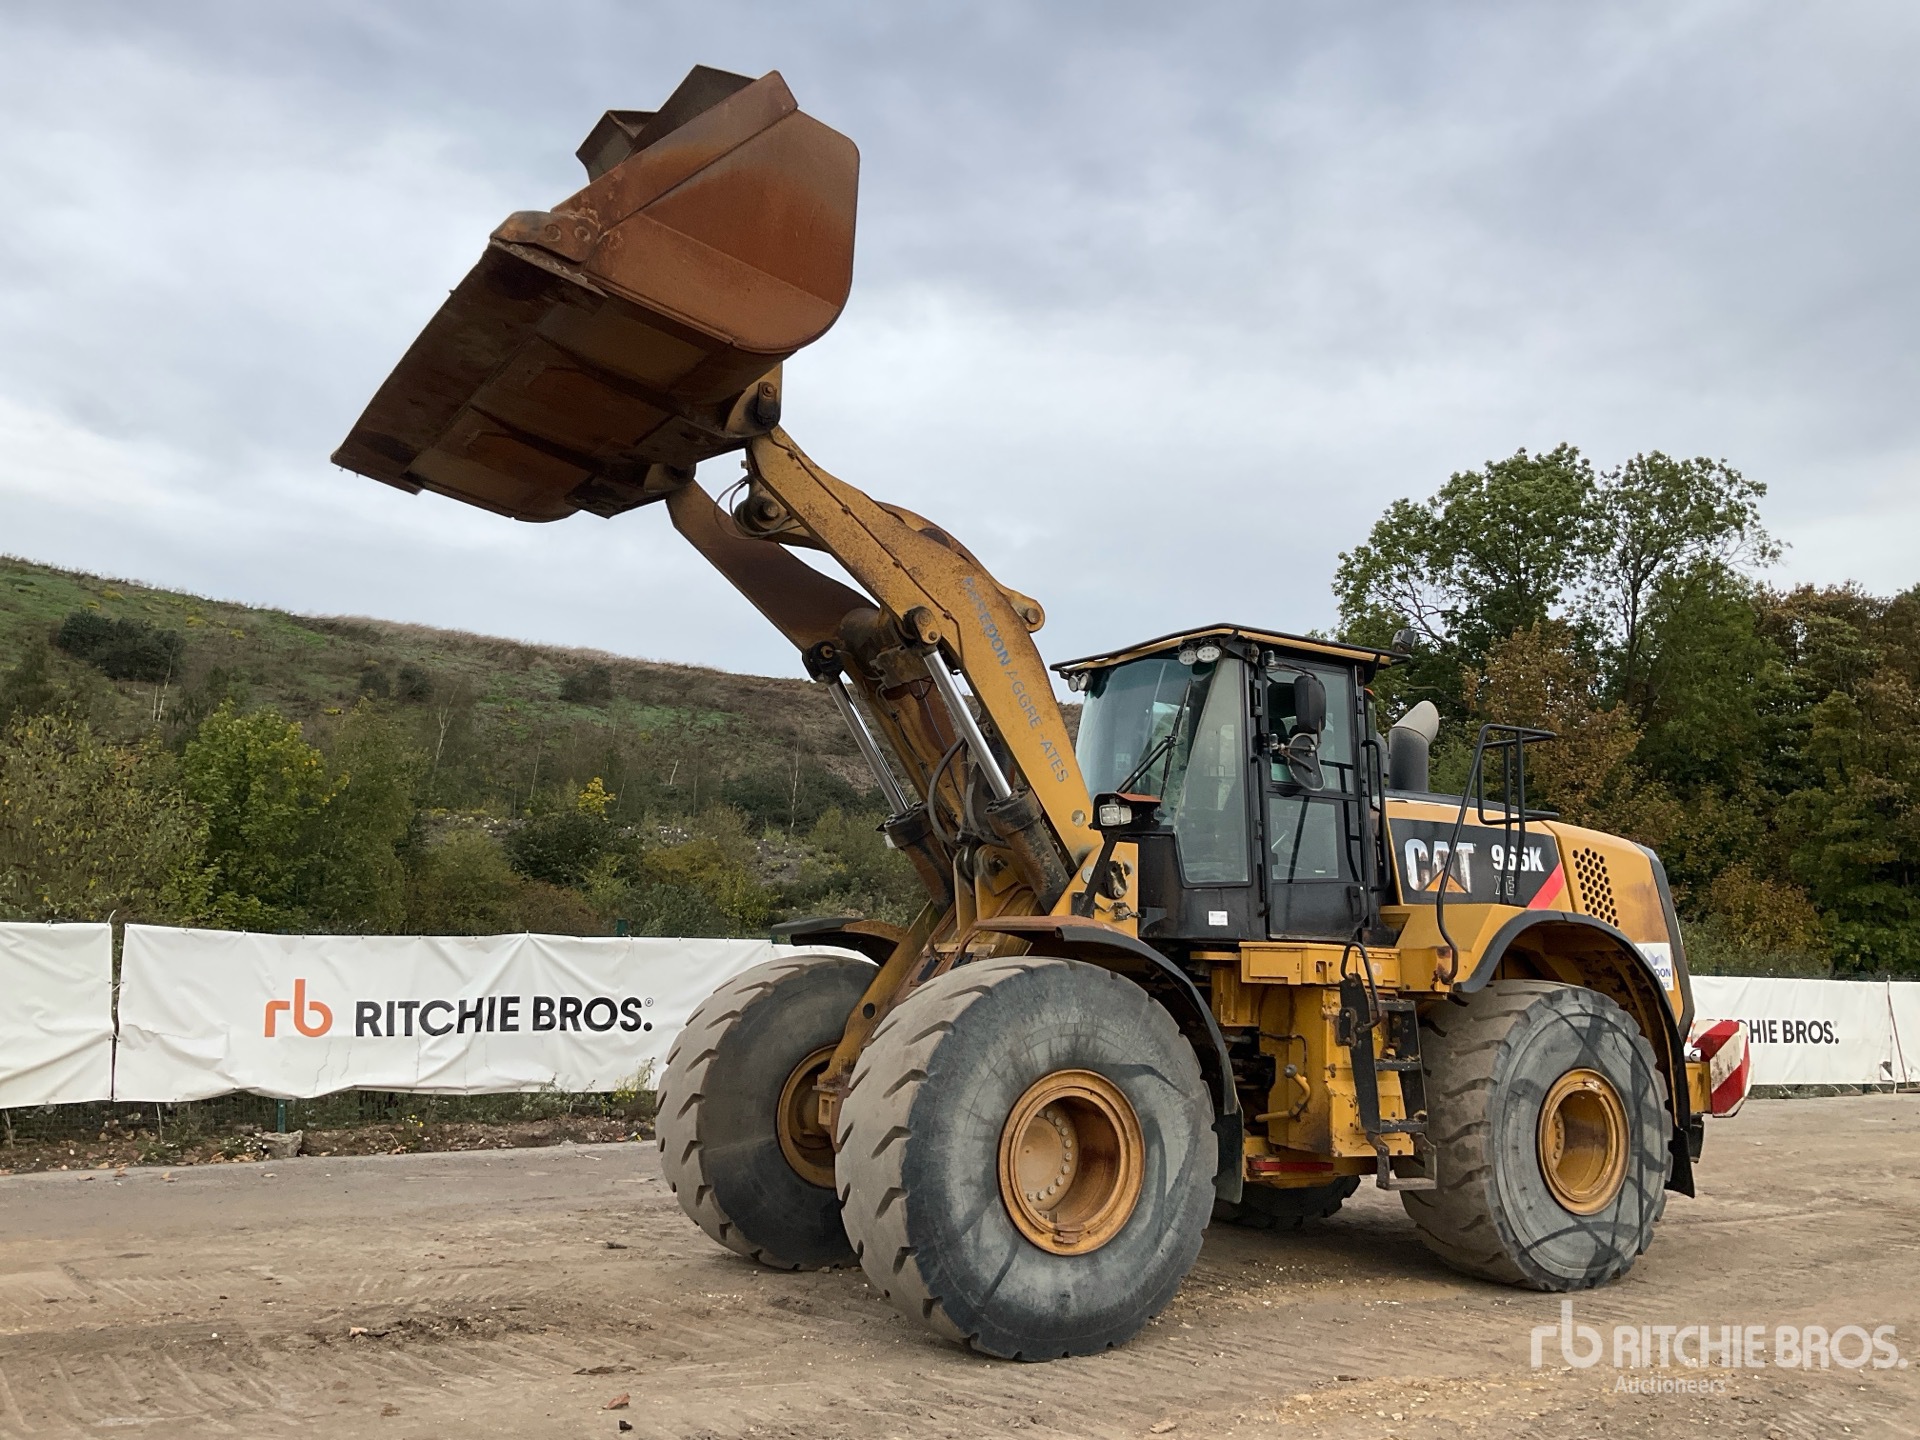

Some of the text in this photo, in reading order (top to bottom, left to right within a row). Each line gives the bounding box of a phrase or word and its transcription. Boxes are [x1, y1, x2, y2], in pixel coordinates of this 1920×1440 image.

[1004, 667, 1069, 782] AGGREATES
[1404, 838, 1545, 893] CAT 966K
[264, 978, 653, 1038] rb RITCHIE BROS.
[1782, 1020, 1840, 1044] BROS.
